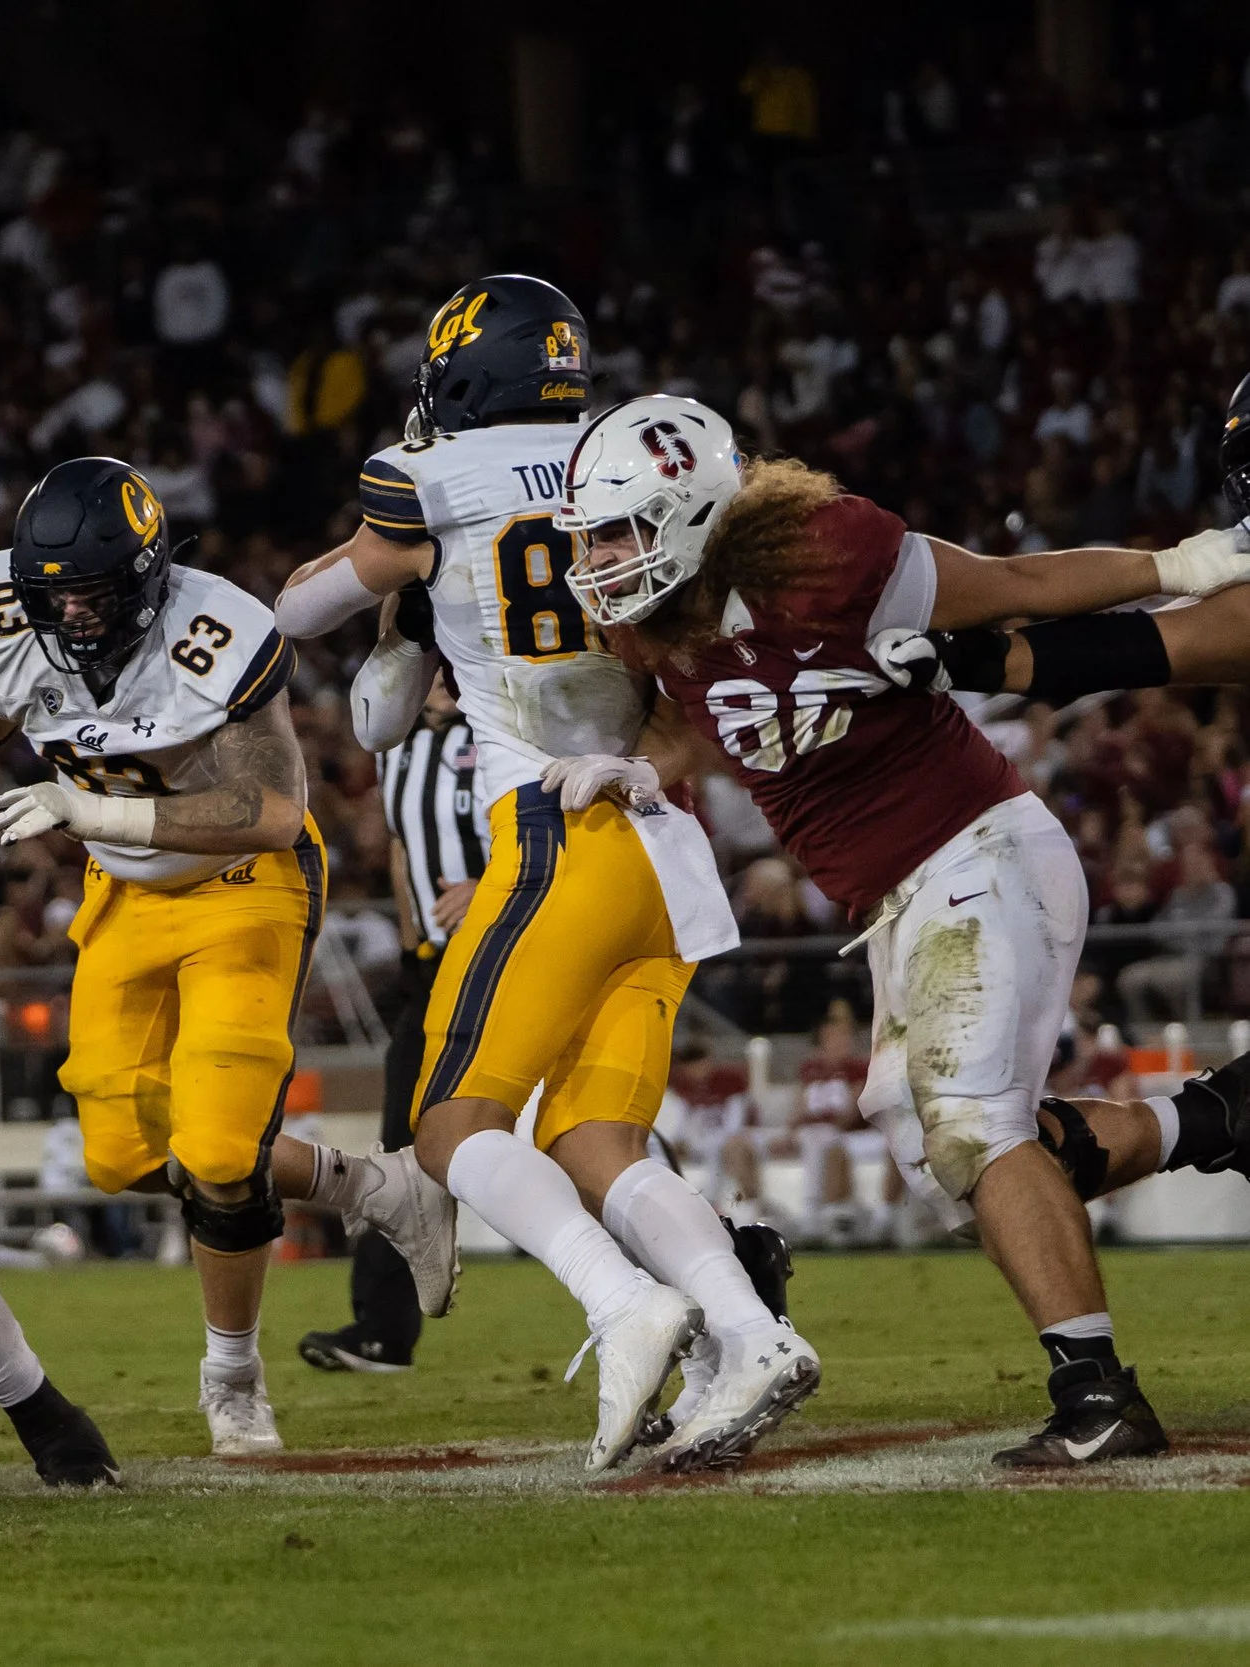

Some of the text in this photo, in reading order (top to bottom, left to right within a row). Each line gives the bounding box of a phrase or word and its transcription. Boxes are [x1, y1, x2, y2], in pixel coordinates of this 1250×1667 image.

[429, 291, 488, 363] Cal
[169, 613, 234, 677] 63
[76, 724, 109, 753] Cal
[221, 861, 258, 884] Cal
[1083, 1394, 1115, 1402] ALPHA
